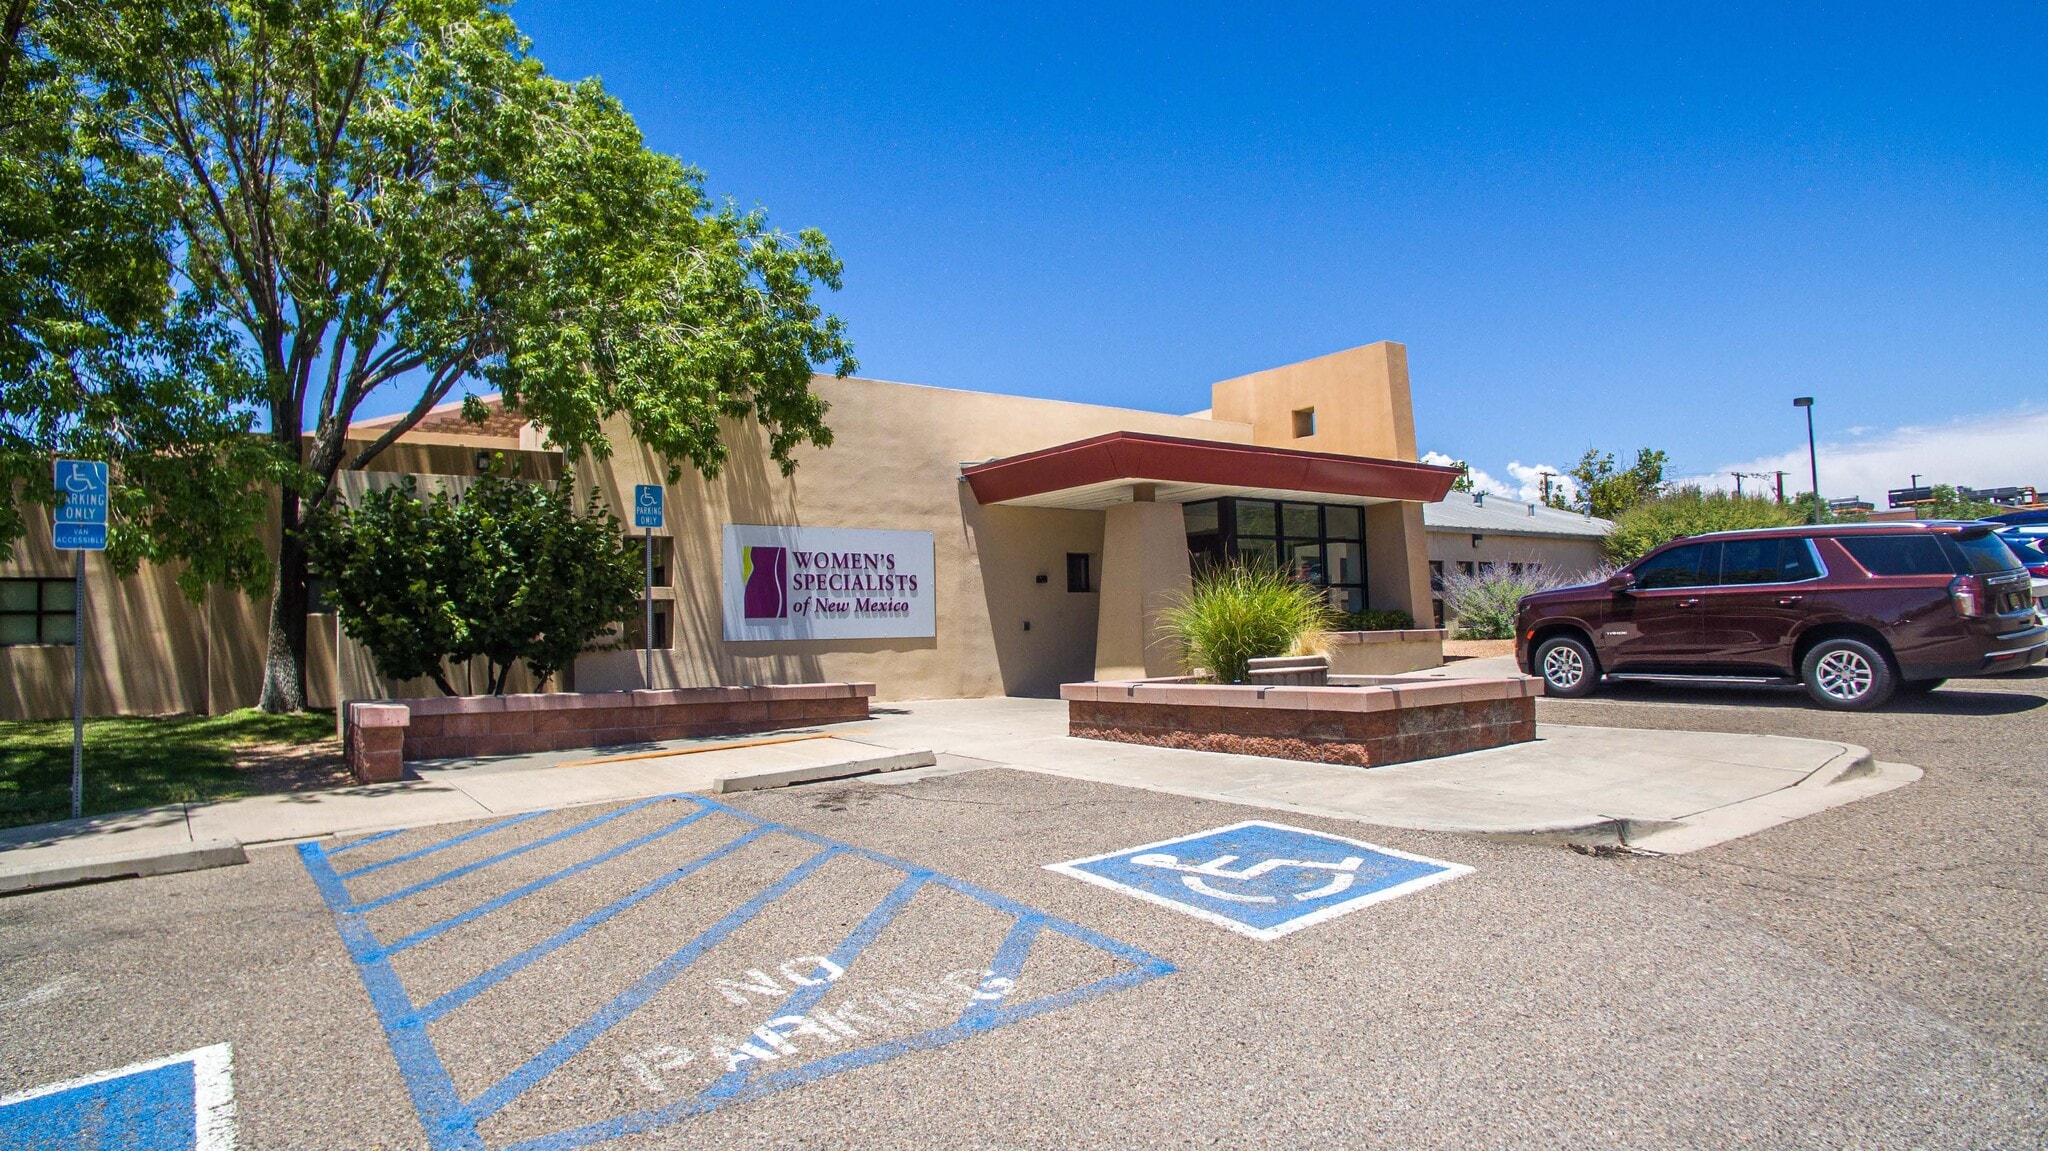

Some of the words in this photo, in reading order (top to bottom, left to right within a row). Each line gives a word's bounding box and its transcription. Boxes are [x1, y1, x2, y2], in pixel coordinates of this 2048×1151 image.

[58, 493, 104, 506] ARKING
[66, 507, 95, 519] ONLY
[636, 506, 661, 515] PARKING
[640, 516, 657, 525] ONLY
[56, 536, 105, 544] ACCESSIBLE
[792, 552, 895, 570] WOMEN'S
[793, 573, 918, 591] SPECIALISTS
[793, 596, 812, 616] of
[814, 597, 850, 613] New
[855, 597, 909, 612] Mexico
[709, 955, 844, 1004] NO
